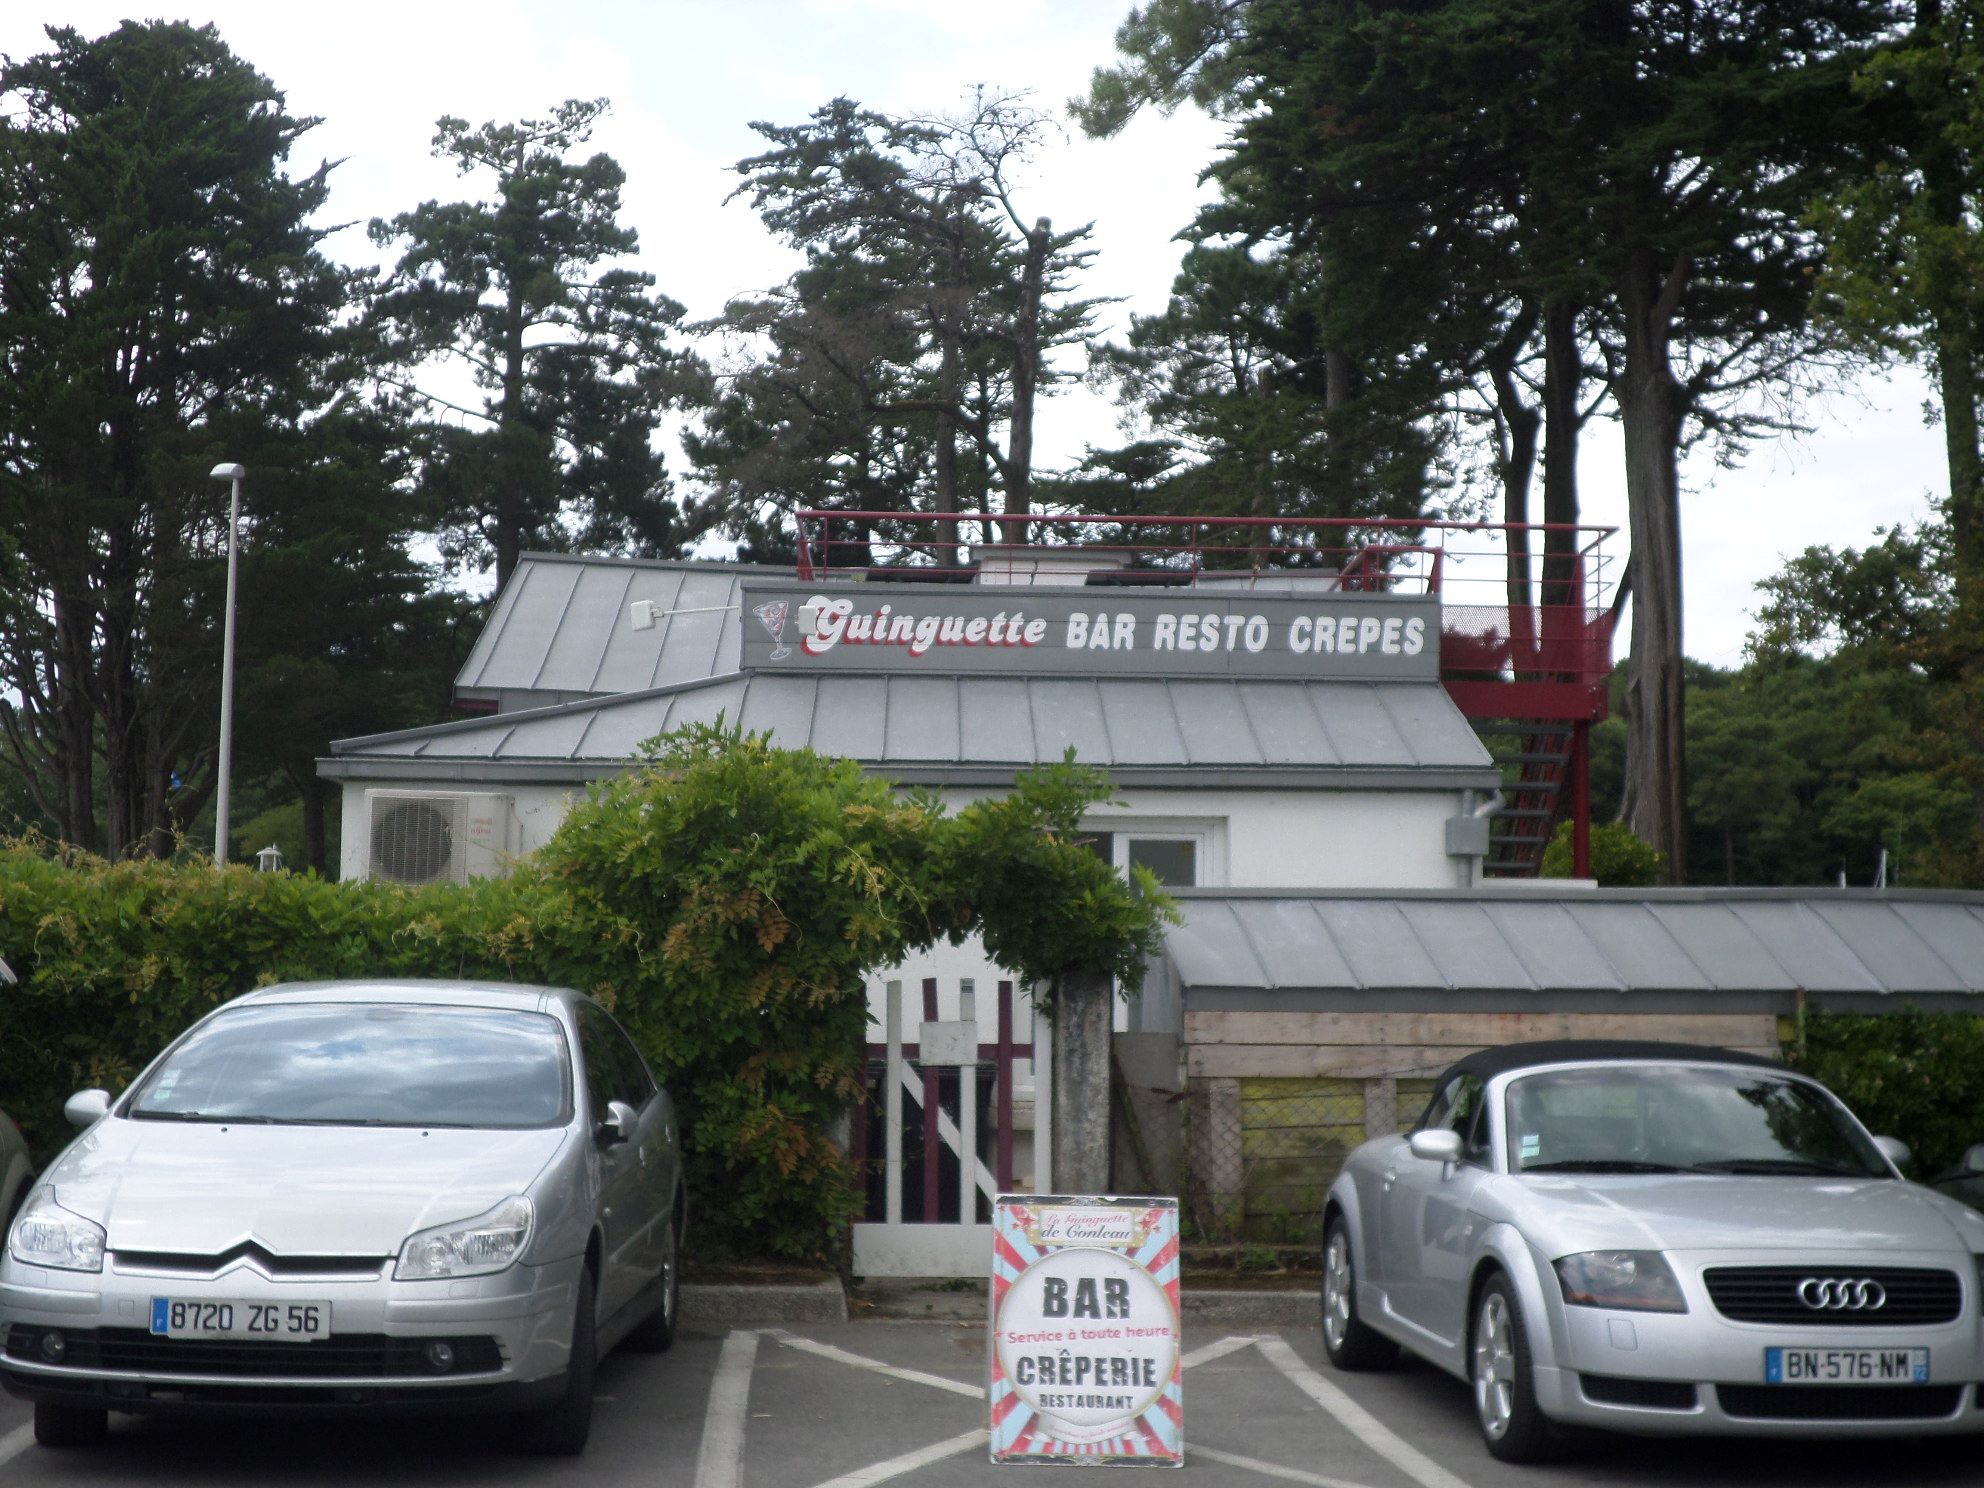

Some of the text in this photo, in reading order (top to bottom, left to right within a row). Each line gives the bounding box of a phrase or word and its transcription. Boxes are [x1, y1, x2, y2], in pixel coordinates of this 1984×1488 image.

[801, 594, 1425, 656] Guinguette BAR RESTO CREPES
[1041, 1224, 1060, 1238] de
[1042, 1277, 1130, 1319] BAR
[171, 1302, 319, 1333] 8720 ZG 56
[1008, 1326, 1170, 1344] Service à toute heure
[1016, 1348, 1157, 1388] CRÊPERIE
[1788, 1352, 1909, 1379] BN-576-NM
[1039, 1393, 1134, 1410] RESTAURANT
